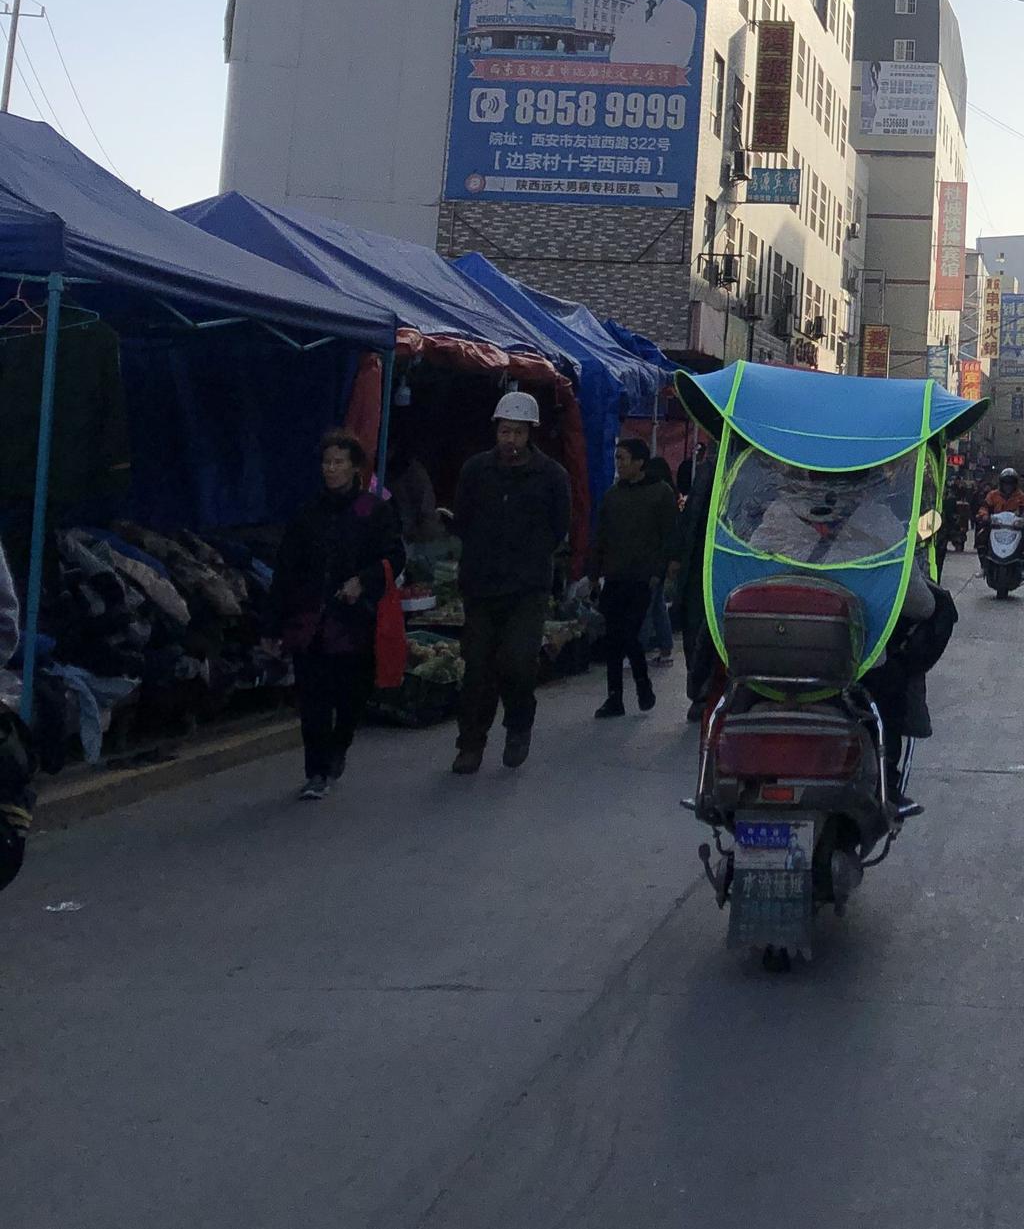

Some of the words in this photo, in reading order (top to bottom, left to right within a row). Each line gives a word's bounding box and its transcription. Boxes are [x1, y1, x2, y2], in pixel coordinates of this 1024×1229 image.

[515, 88, 597, 126] 8958
[604, 92, 687, 130] 9999
[515, 179, 641, 194] 陕西远大男病专科医院
[982, 291, 1000, 356] 串串火锅
